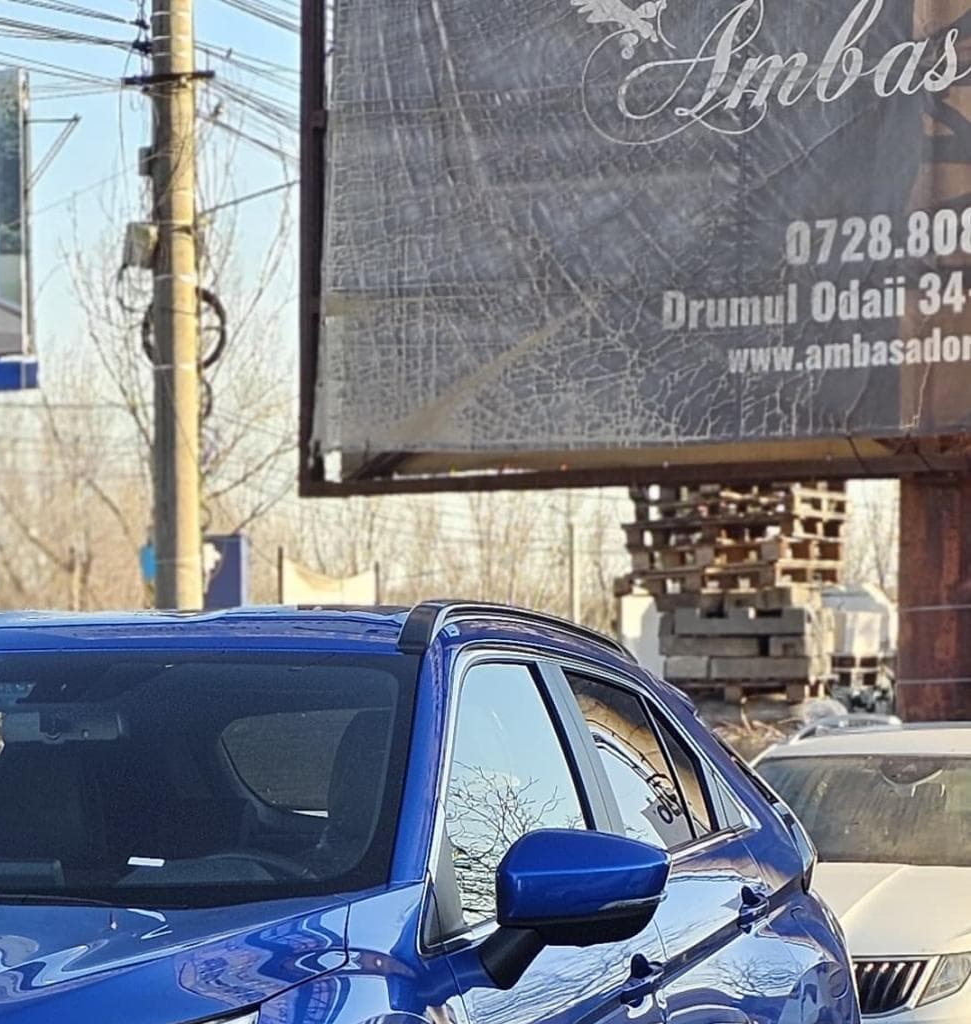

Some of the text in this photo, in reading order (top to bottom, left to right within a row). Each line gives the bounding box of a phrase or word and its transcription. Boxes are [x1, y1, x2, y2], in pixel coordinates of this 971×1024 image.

[662, 270, 971, 330] Drumul Odaii 34
